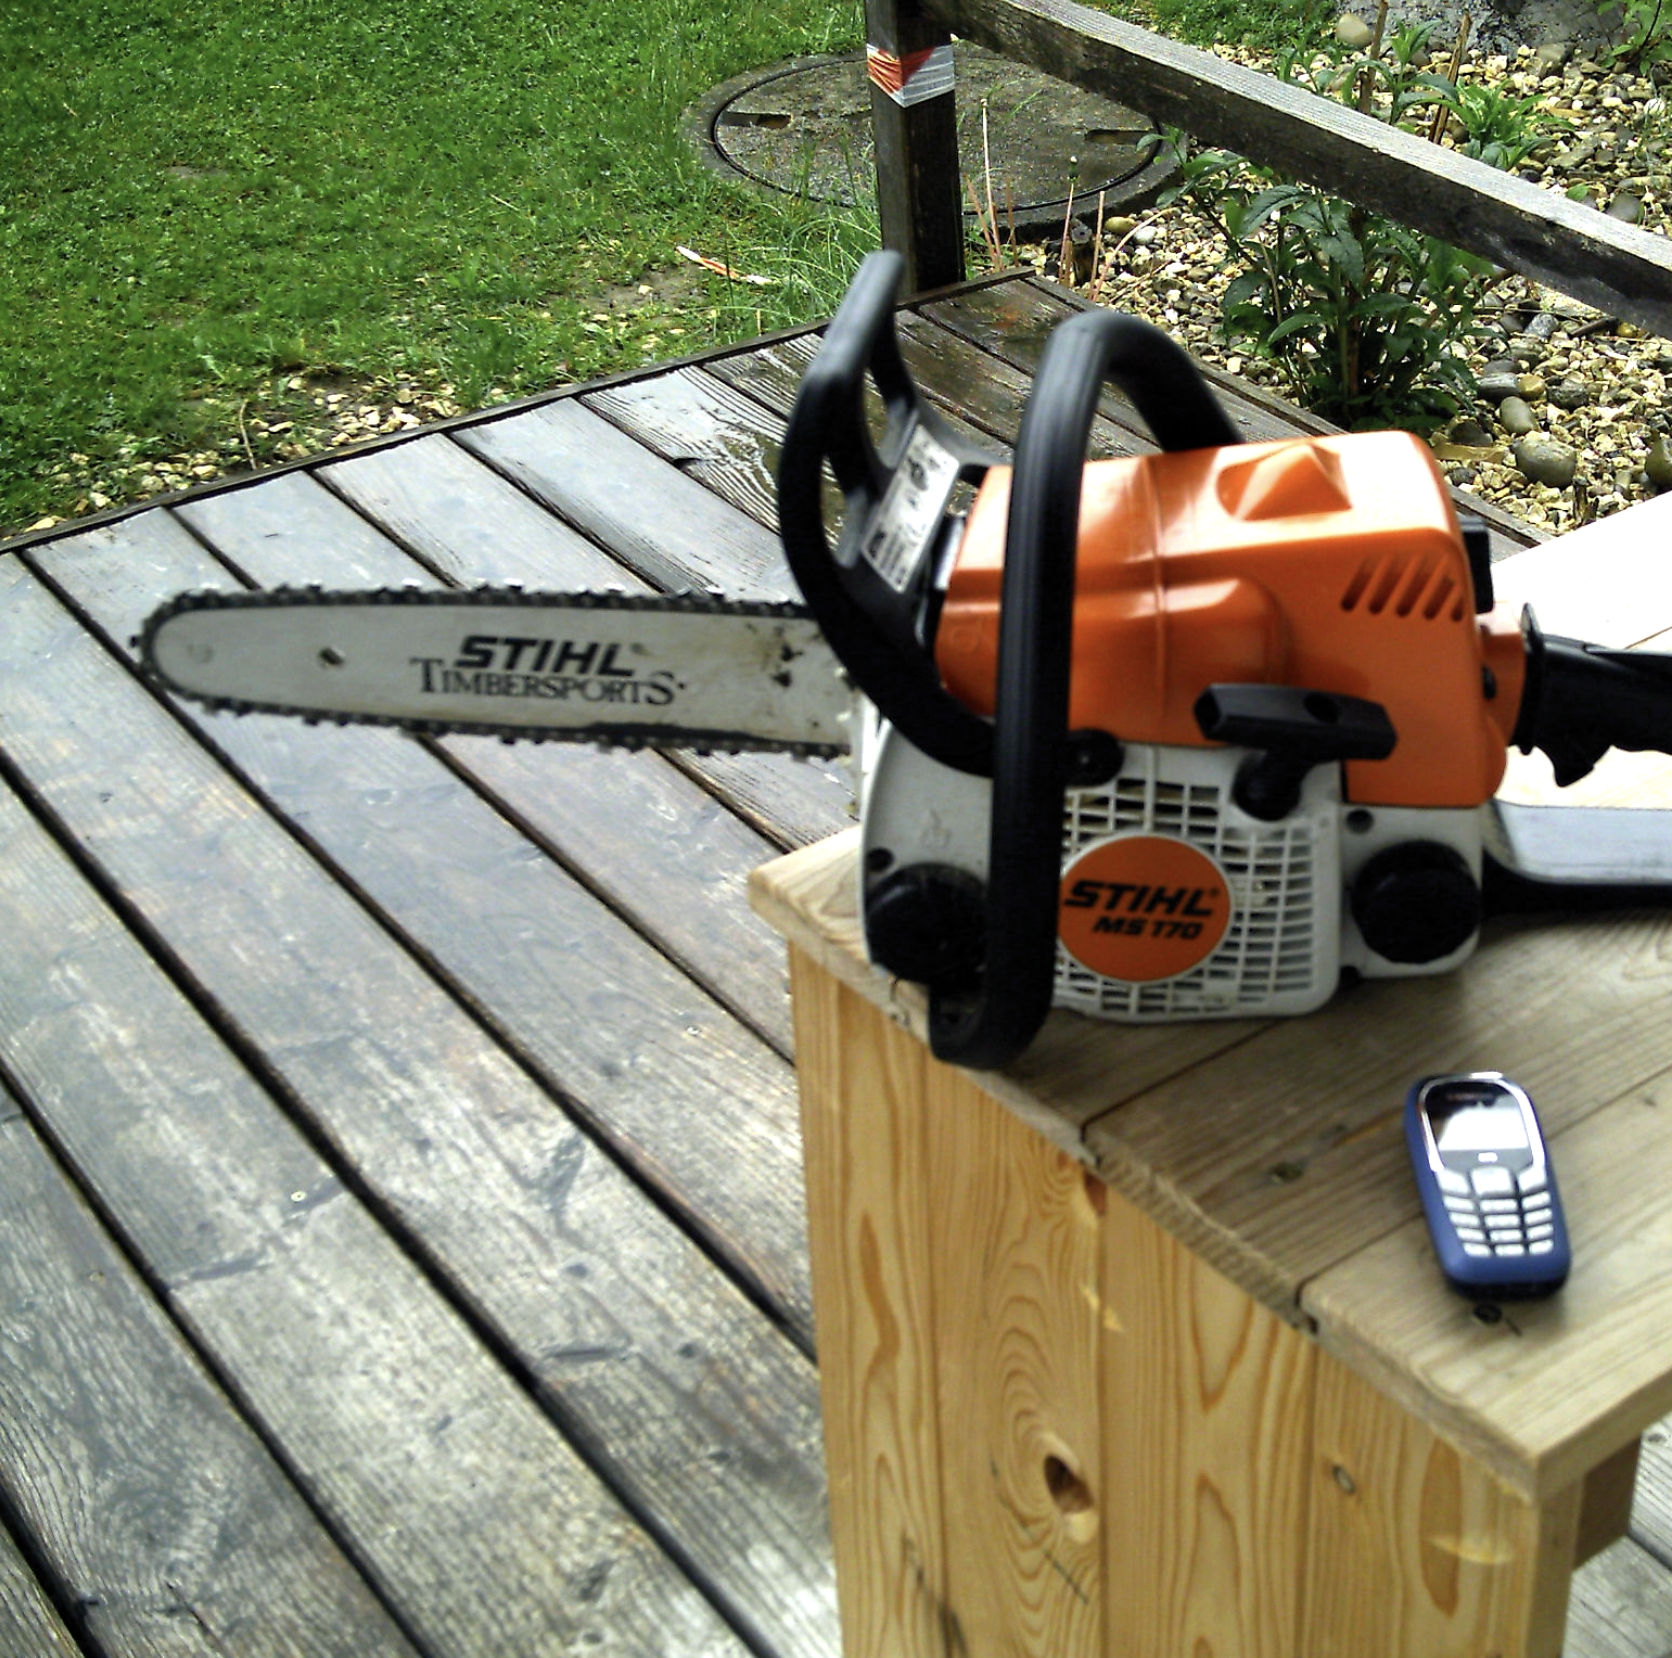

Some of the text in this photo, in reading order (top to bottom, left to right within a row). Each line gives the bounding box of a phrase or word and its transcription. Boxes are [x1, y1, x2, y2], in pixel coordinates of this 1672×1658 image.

[454, 635, 634, 677] STIHL
[1064, 880, 1213, 917] STIHL
[1093, 917, 1203, 940] MS 170
